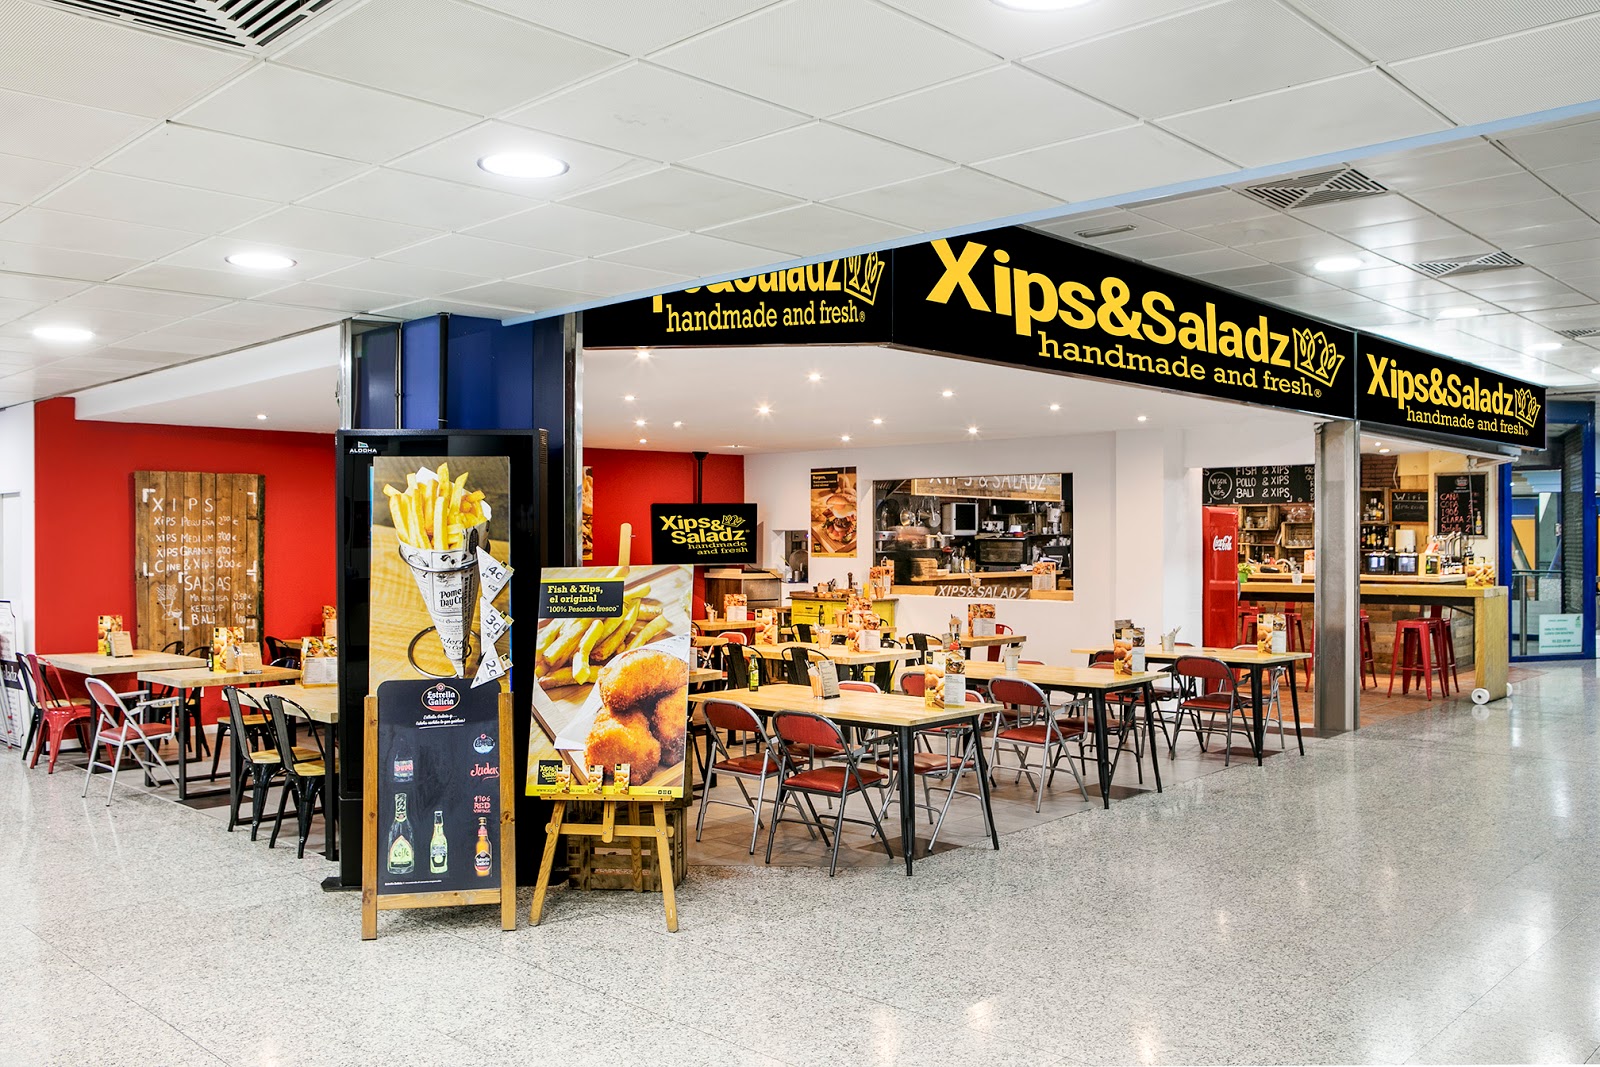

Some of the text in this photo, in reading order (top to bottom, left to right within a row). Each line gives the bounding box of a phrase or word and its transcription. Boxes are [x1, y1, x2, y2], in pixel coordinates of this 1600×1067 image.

[926, 238, 1291, 367] Xips&Saladz
[666, 302, 777, 332] handmade
[783, 300, 815, 326] and
[1039, 331, 1206, 380] handmade
[1214, 364, 1258, 388] and
[1366, 353, 1514, 416] Xips&Saladz
[1406, 405, 1475, 429] handmade
[1477, 418, 1498, 432] and
[1261, 466, 1269, 475] &
[1271, 466, 1290, 475] XIPS
[1235, 475, 1290, 487] POLLO & XIPS
[1235, 487, 1290, 498] BALI & XIPS
[659, 515, 725, 533] Xips&
[671, 527, 746, 544] Saladz
[688, 541, 747, 550] handmade
[184, 558, 192, 571] &
[184, 575, 232, 592] SALSAS
[547, 585, 603, 594] Fish & Xips,
[549, 594, 597, 604] el original
[568, 605, 596, 613] Pescado
[427, 691, 456, 699] Estrella
[428, 698, 454, 706] Galicia
